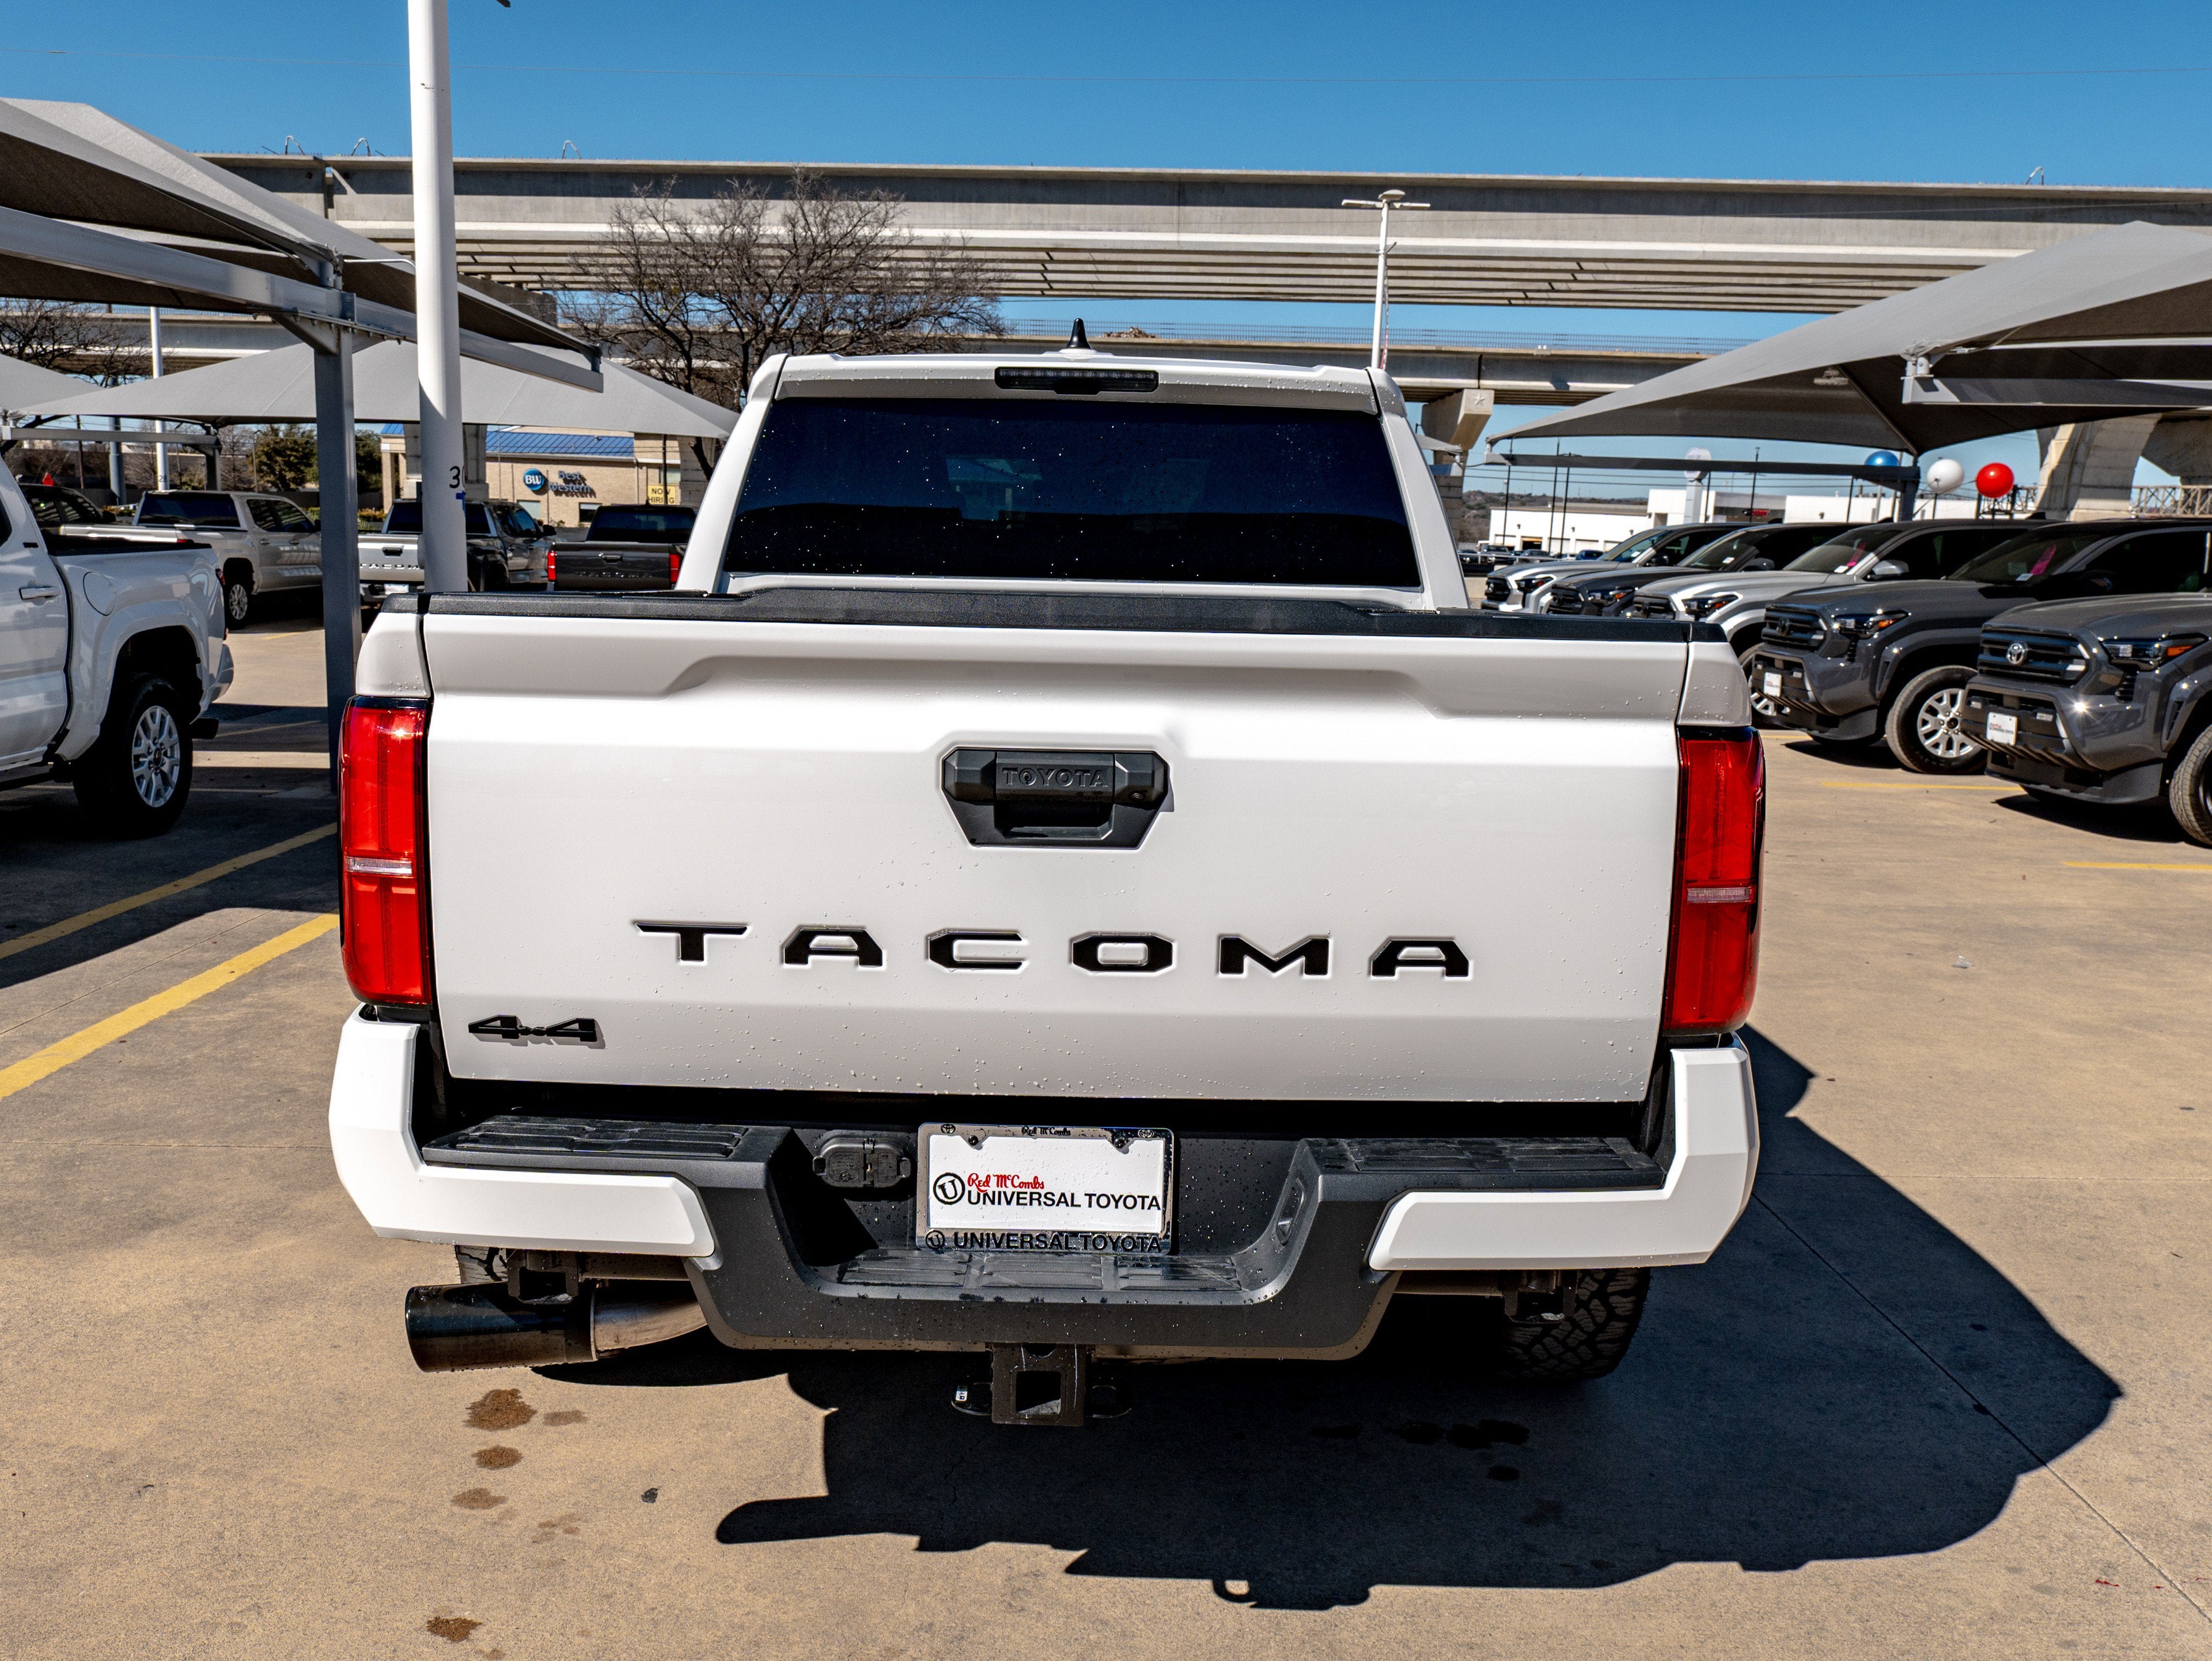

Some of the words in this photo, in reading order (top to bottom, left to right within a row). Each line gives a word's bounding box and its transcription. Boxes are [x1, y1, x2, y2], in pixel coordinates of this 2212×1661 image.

[449, 466, 465, 489] 3
[525, 475, 541, 485] BW
[558, 470, 581, 480] Best
[548, 481, 590, 493] Western
[1002, 767, 1109, 788] TOYOTA
[635, 922, 1471, 978] TACOMA
[1021, 1125, 1037, 1137] Red
[1038, 1127, 1071, 1136] McCombs
[967, 1173, 991, 1193] Red
[993, 1174, 1045, 1190] McCombs
[968, 1190, 1081, 1208] UNIVERSAL
[1085, 1193, 1161, 1210] TOYOTA
[954, 1231, 1076, 1250] UNIVERSAL
[1079, 1233, 1162, 1253] TOYOTA
